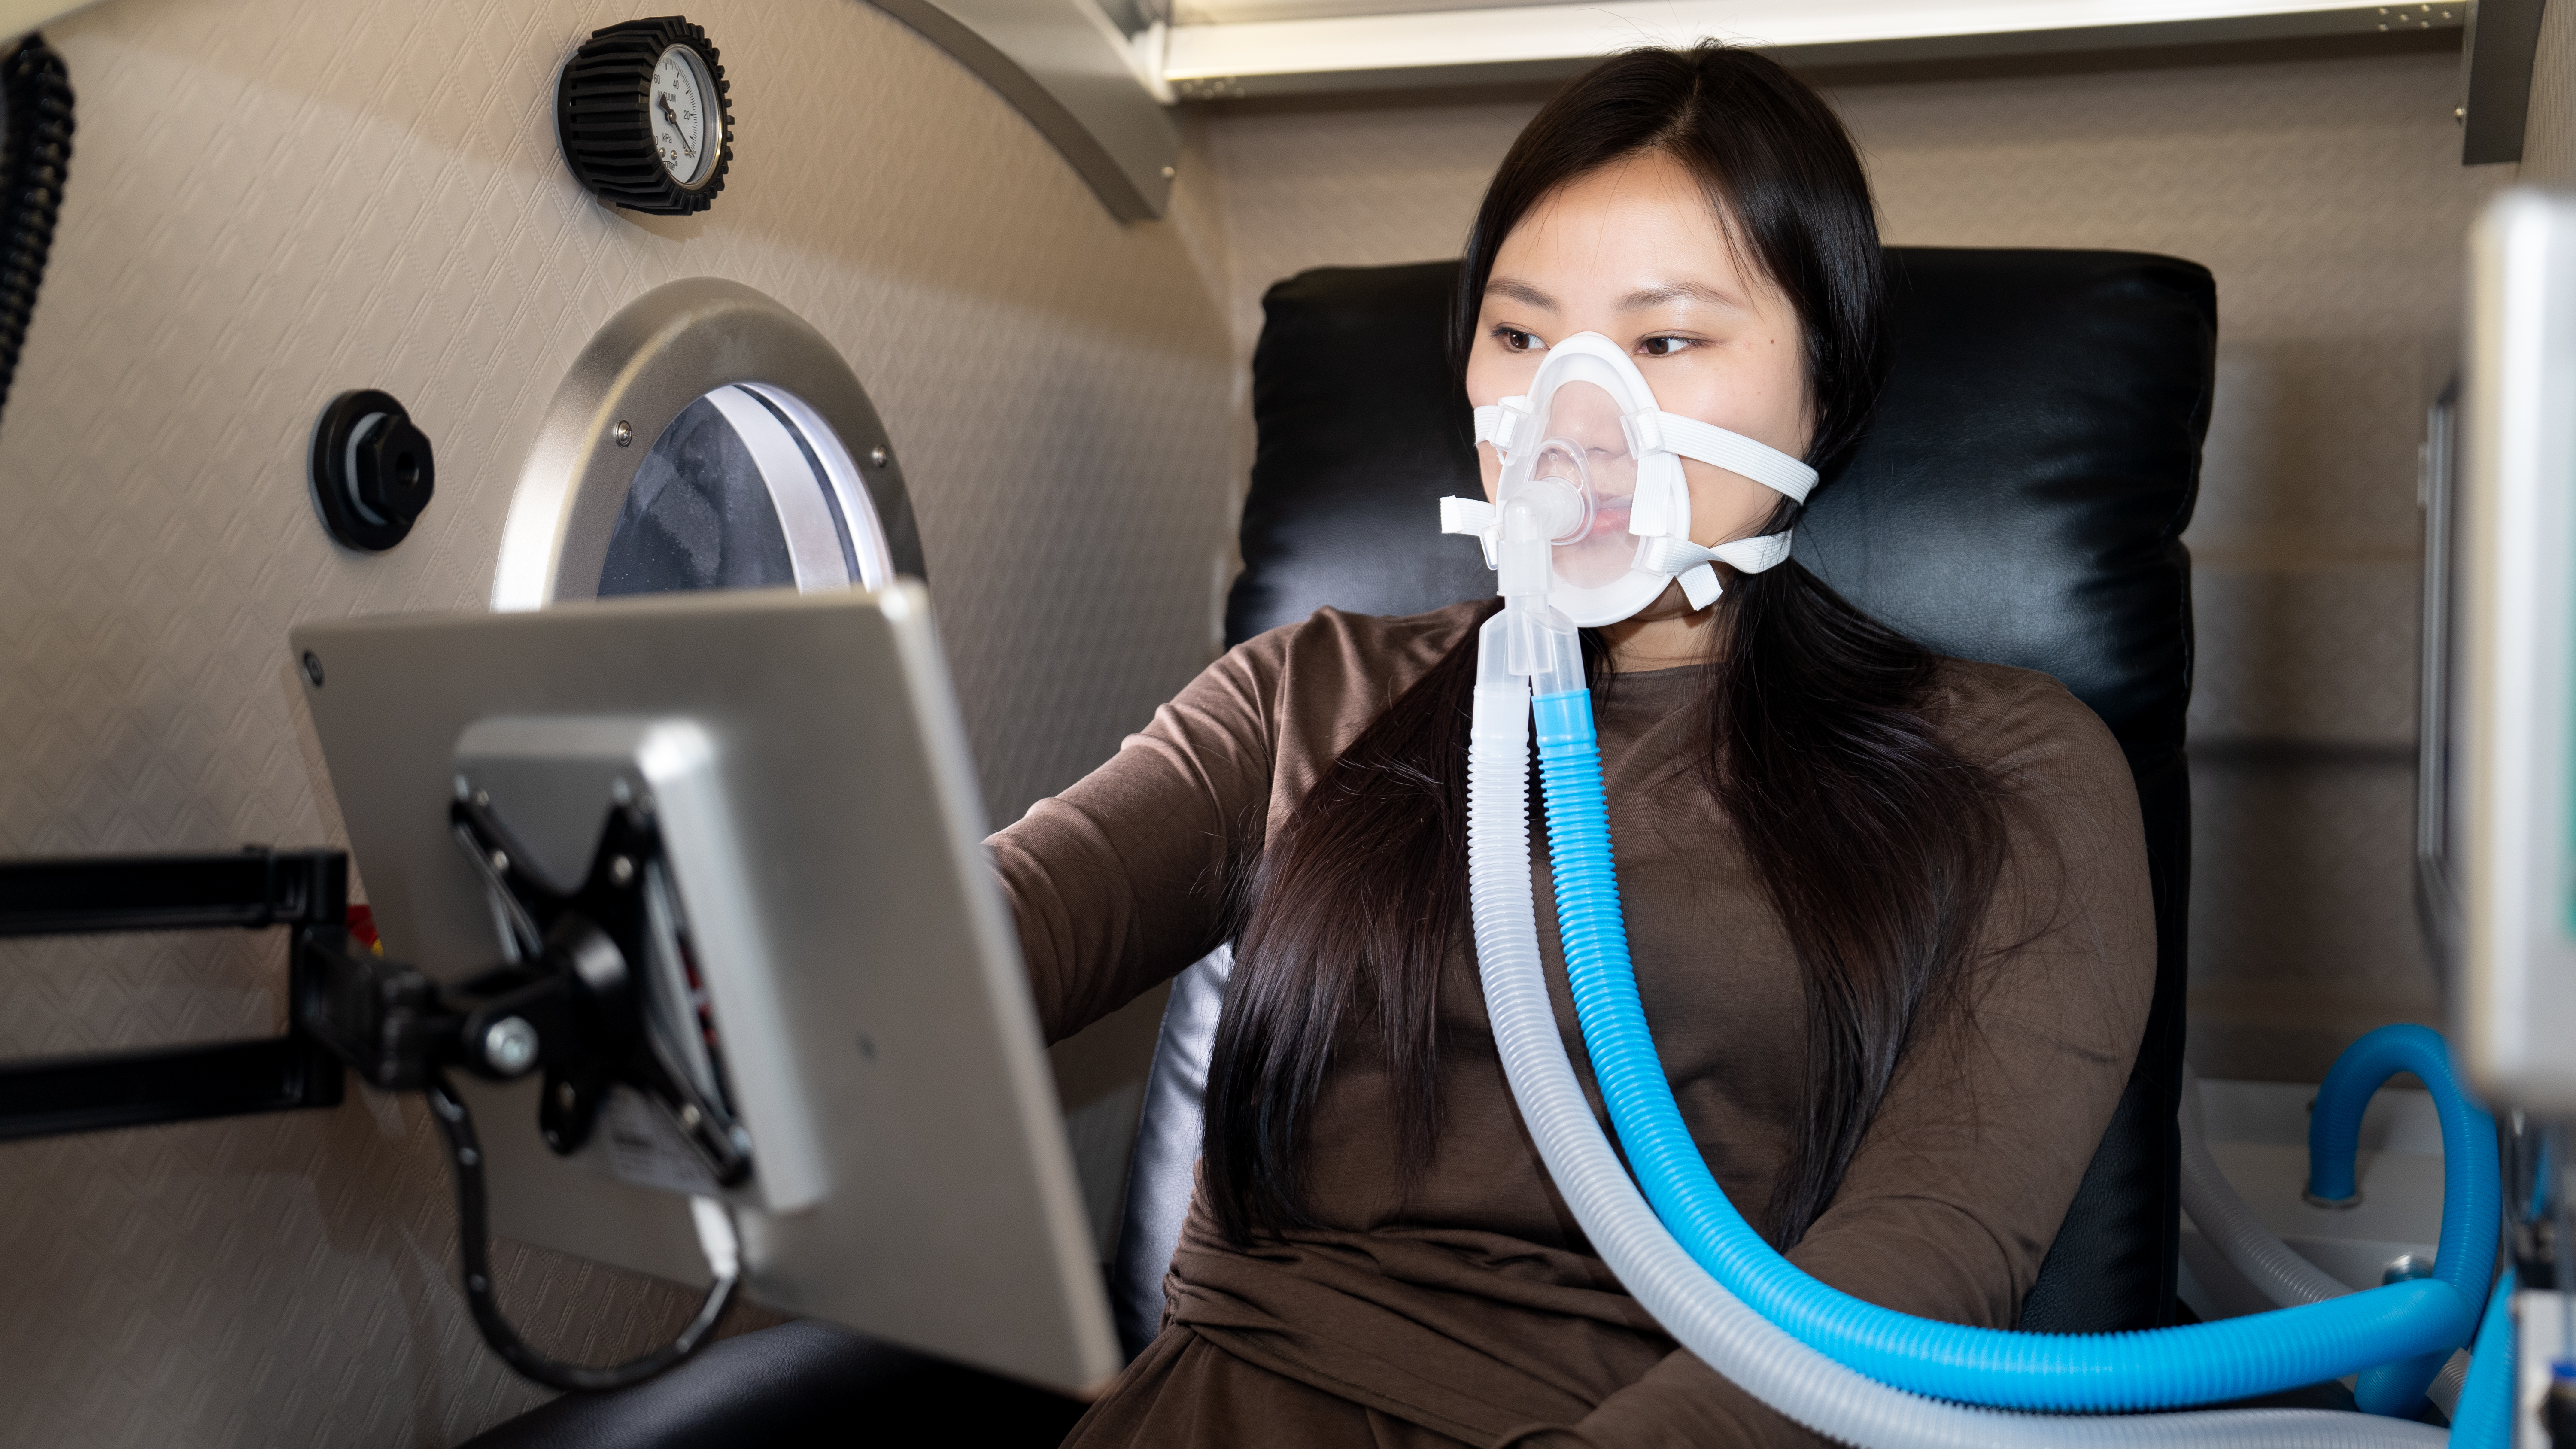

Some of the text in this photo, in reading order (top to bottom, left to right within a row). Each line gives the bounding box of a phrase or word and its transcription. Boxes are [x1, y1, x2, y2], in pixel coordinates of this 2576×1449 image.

[654, 73, 660, 84] 60
[673, 79, 679, 89] 40
[657, 90, 676, 103] VUUM
[683, 109, 690, 120] 20
[662, 132, 672, 143] kPa
